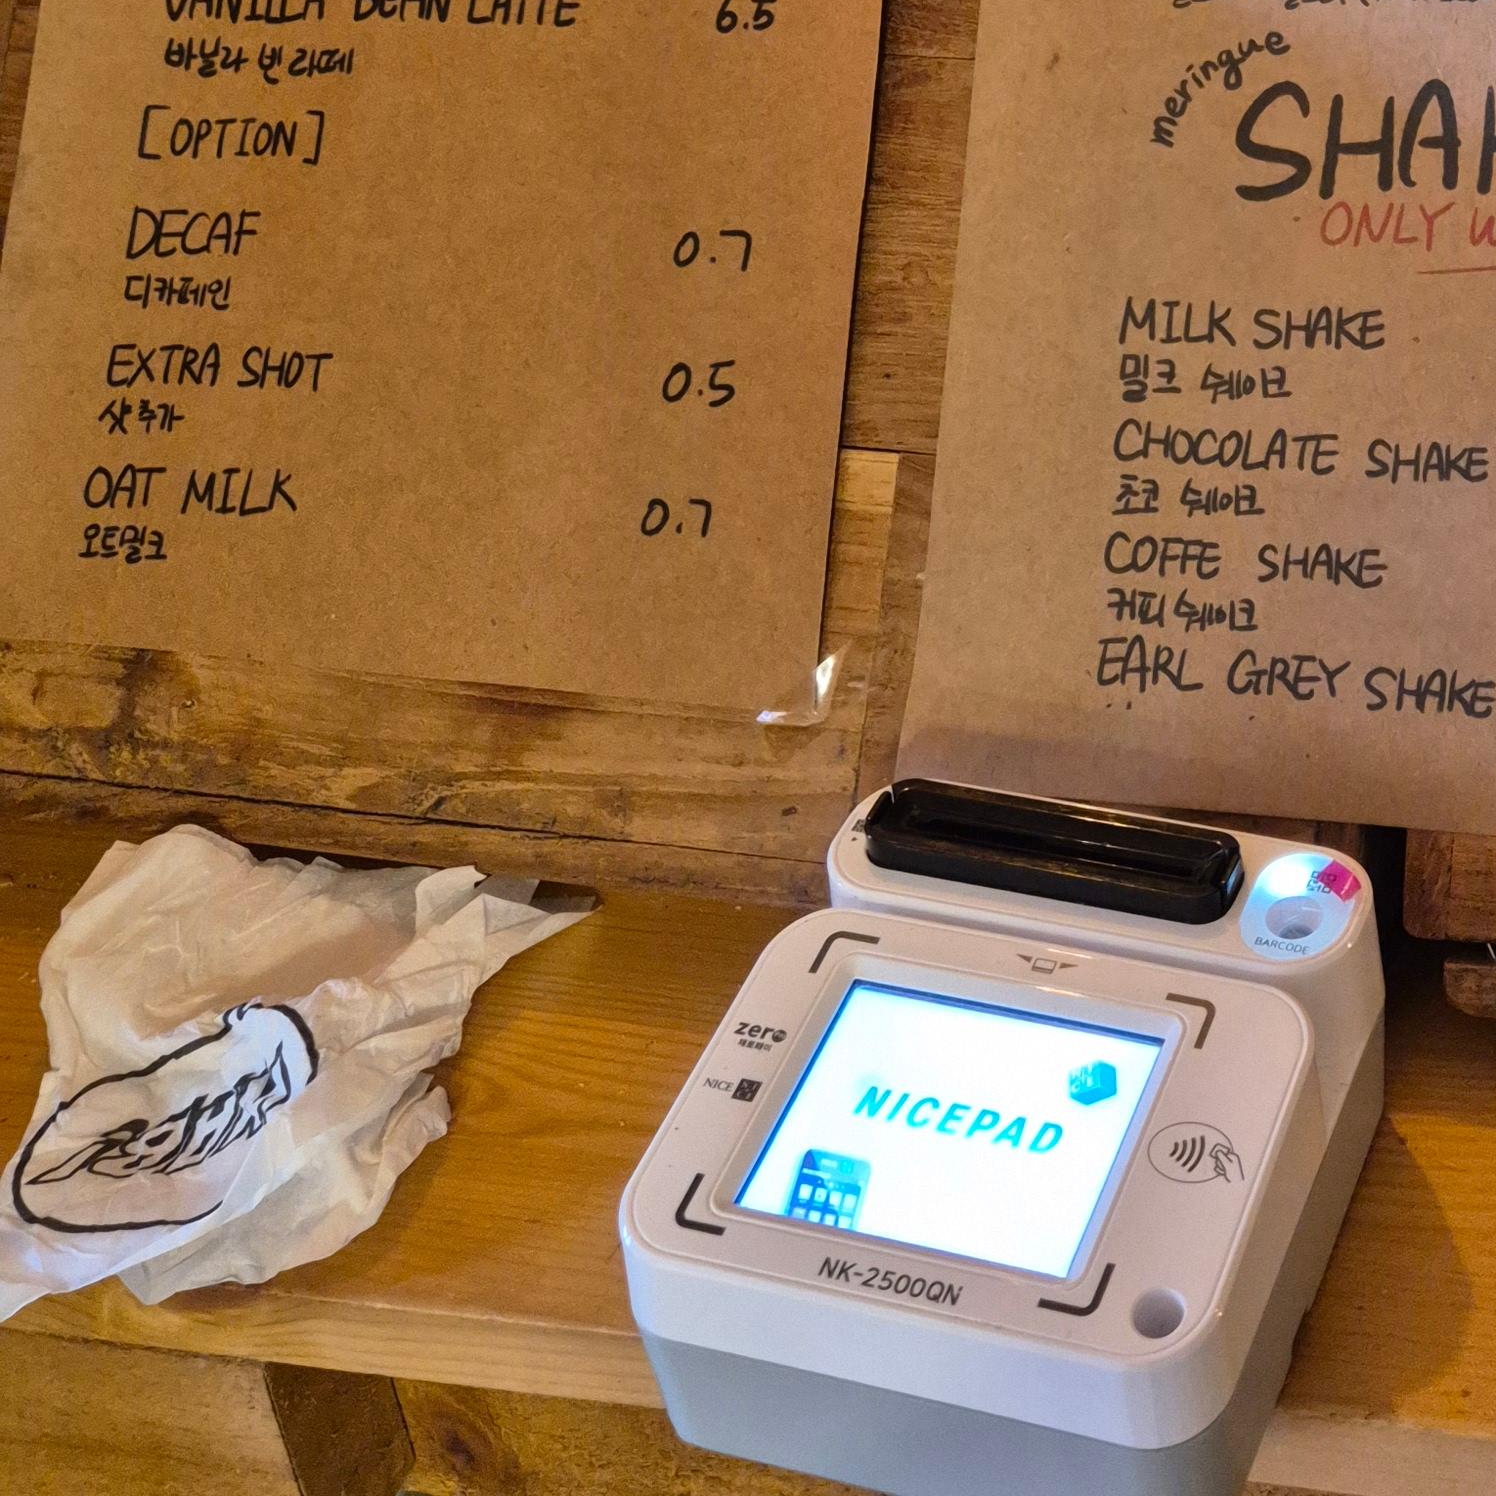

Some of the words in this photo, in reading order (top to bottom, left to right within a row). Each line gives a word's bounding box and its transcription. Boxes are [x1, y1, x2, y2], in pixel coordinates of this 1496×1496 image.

[164, 36, 249, 79] 바닐라
[288, 47, 355, 79] 라떼
[1150, 27, 1291, 149] meringue
[138, 105, 325, 165] [OPTION]
[125, 206, 261, 261] DECAF
[673, 229, 753, 272] 0.7
[1319, 201, 1456, 252] ONLY
[124, 274, 232, 311] 디카페인
[1119, 297, 1236, 347] MILK
[1252, 305, 1386, 351] SHAKE
[106, 342, 222, 389] EXTRA
[237, 346, 333, 392] SHOT
[661, 360, 736, 408] 0.5
[1120, 353, 1182, 403] 밀크
[1200, 362, 1293, 401] 쉐이크
[1113, 418, 1339, 476] CHOCOLATE
[1365, 438, 1490, 484] SHAKE
[83, 463, 167, 509] OAT
[181, 468, 298, 517] MILK
[640, 497, 713, 539] 0.7
[1112, 473, 1160, 516] 초코
[1180, 477, 1266, 518] 쉐이크
[78, 522, 168, 565] 오트밀크
[1104, 530, 1222, 581] COFFE
[1257, 543, 1388, 589] SHAKE
[1107, 587, 1166, 628] 커피
[1174, 587, 1259, 633] 쉐이크
[1097, 634, 1204, 693] EARL
[1227, 647, 1352, 701] GREY
[1365, 668, 1496, 719] SHAKE
[1254, 936, 1312, 956] BARCODE
[703, 1077, 735, 1092] NICE
[852, 1084, 1066, 1157] NICEPAD
[817, 1254, 965, 1308] NK-2500QN
